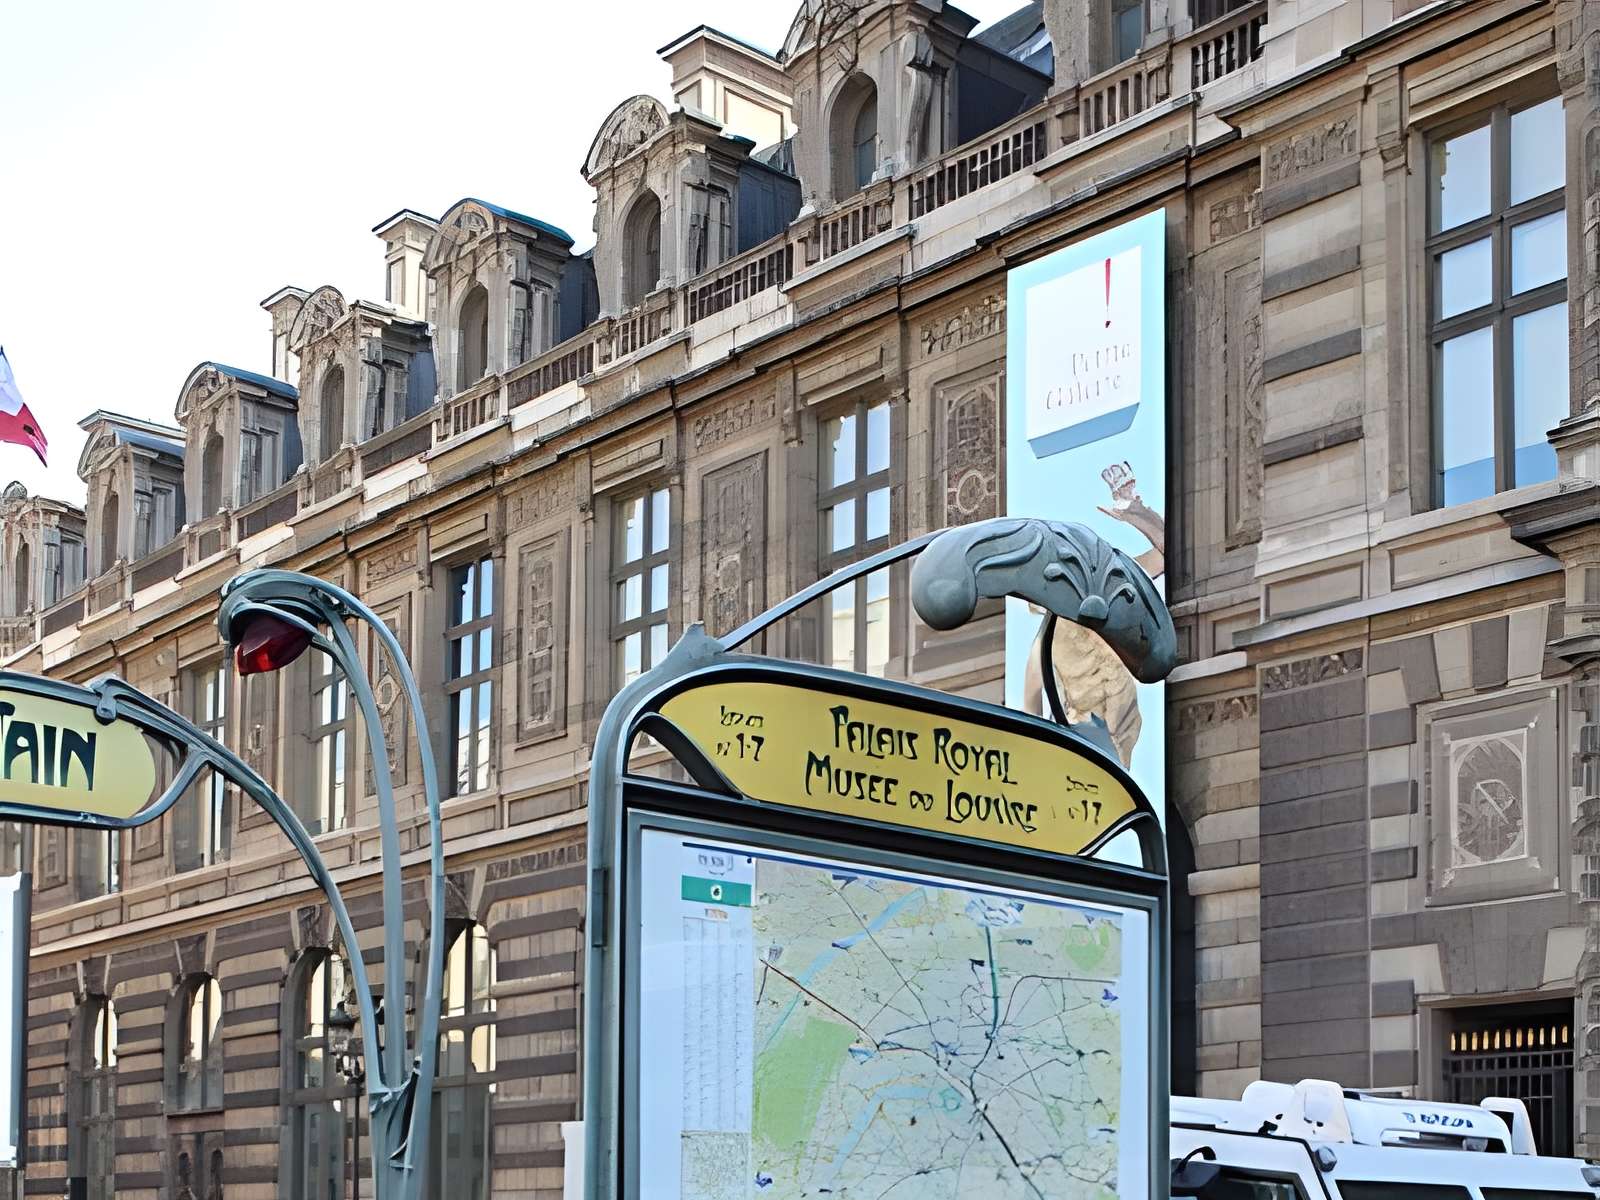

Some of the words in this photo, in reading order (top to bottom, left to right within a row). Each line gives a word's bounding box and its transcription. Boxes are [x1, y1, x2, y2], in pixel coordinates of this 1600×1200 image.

[805, 750, 898, 806] MUSEE
[829, 705, 918, 760] PALAIS
[934, 727, 1018, 785] ROYAL
